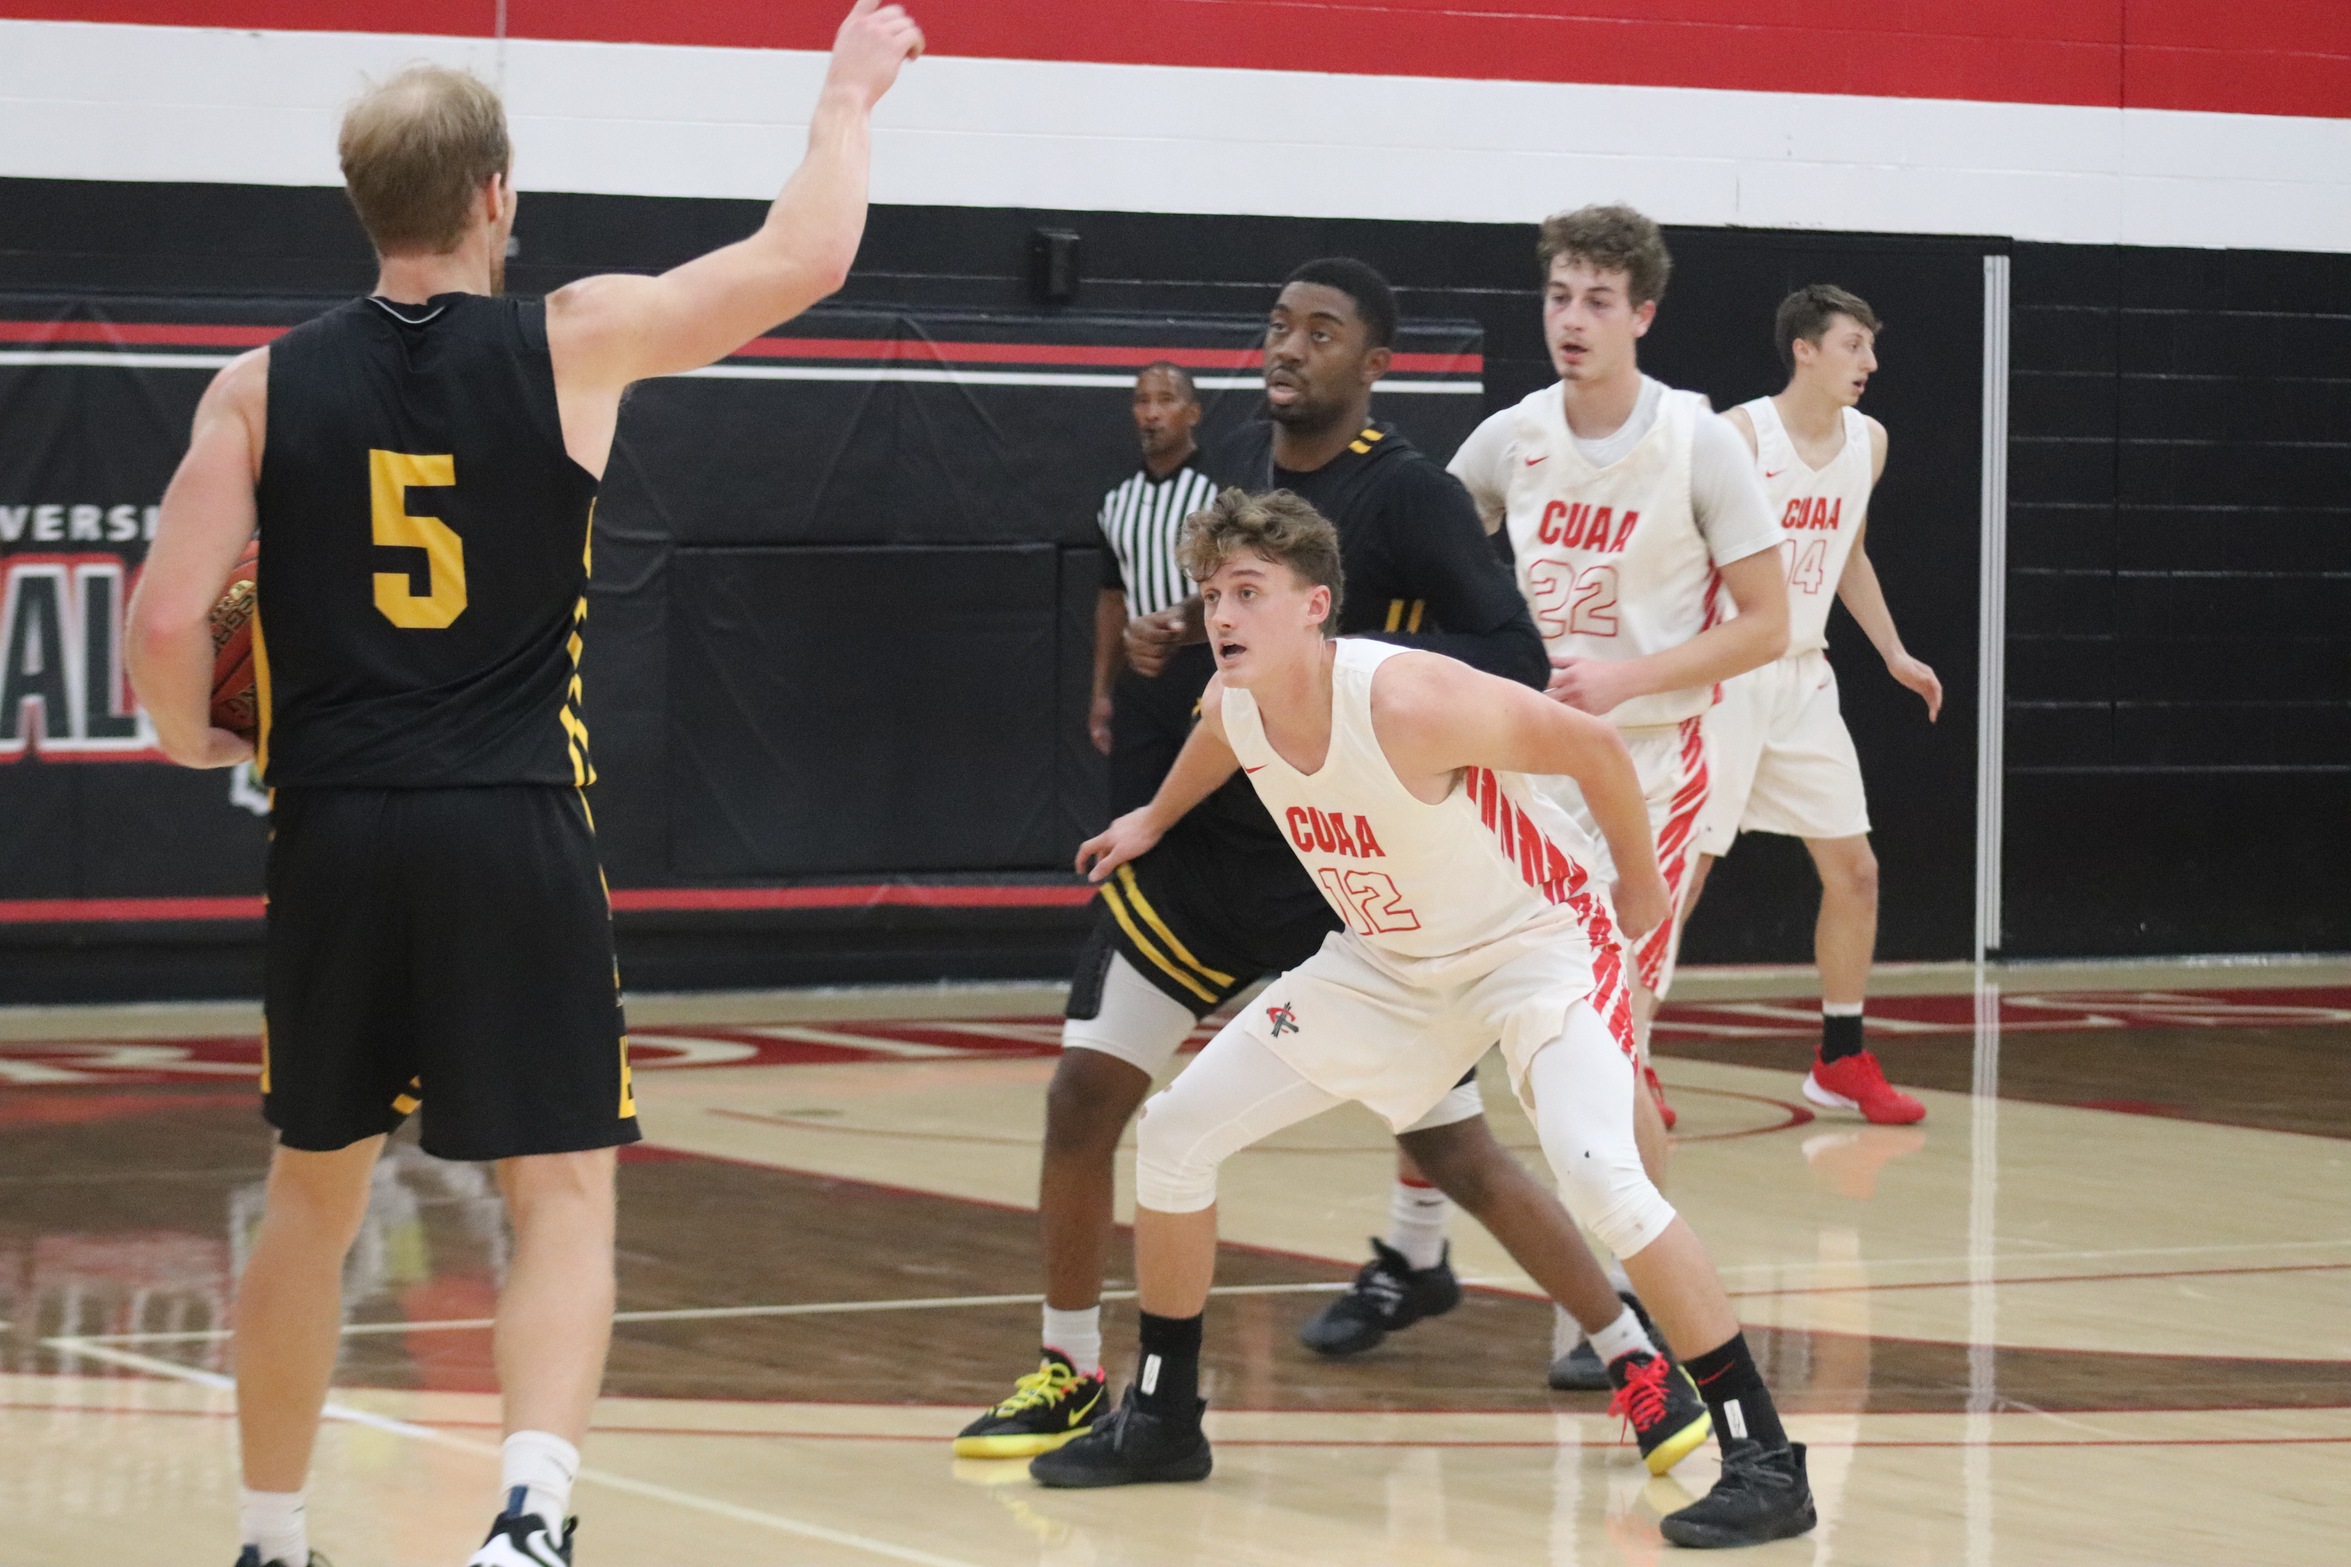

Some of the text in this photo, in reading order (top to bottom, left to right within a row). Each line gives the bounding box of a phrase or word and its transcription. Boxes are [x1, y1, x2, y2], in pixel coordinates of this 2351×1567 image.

[369, 449, 468, 629] 5
[1538, 500, 1640, 553] CUAA
[1781, 496, 1842, 531] CUAA
[1527, 559, 1620, 640] 22
[1285, 806, 1387, 858] CUAA
[1317, 867, 1422, 936] 12
